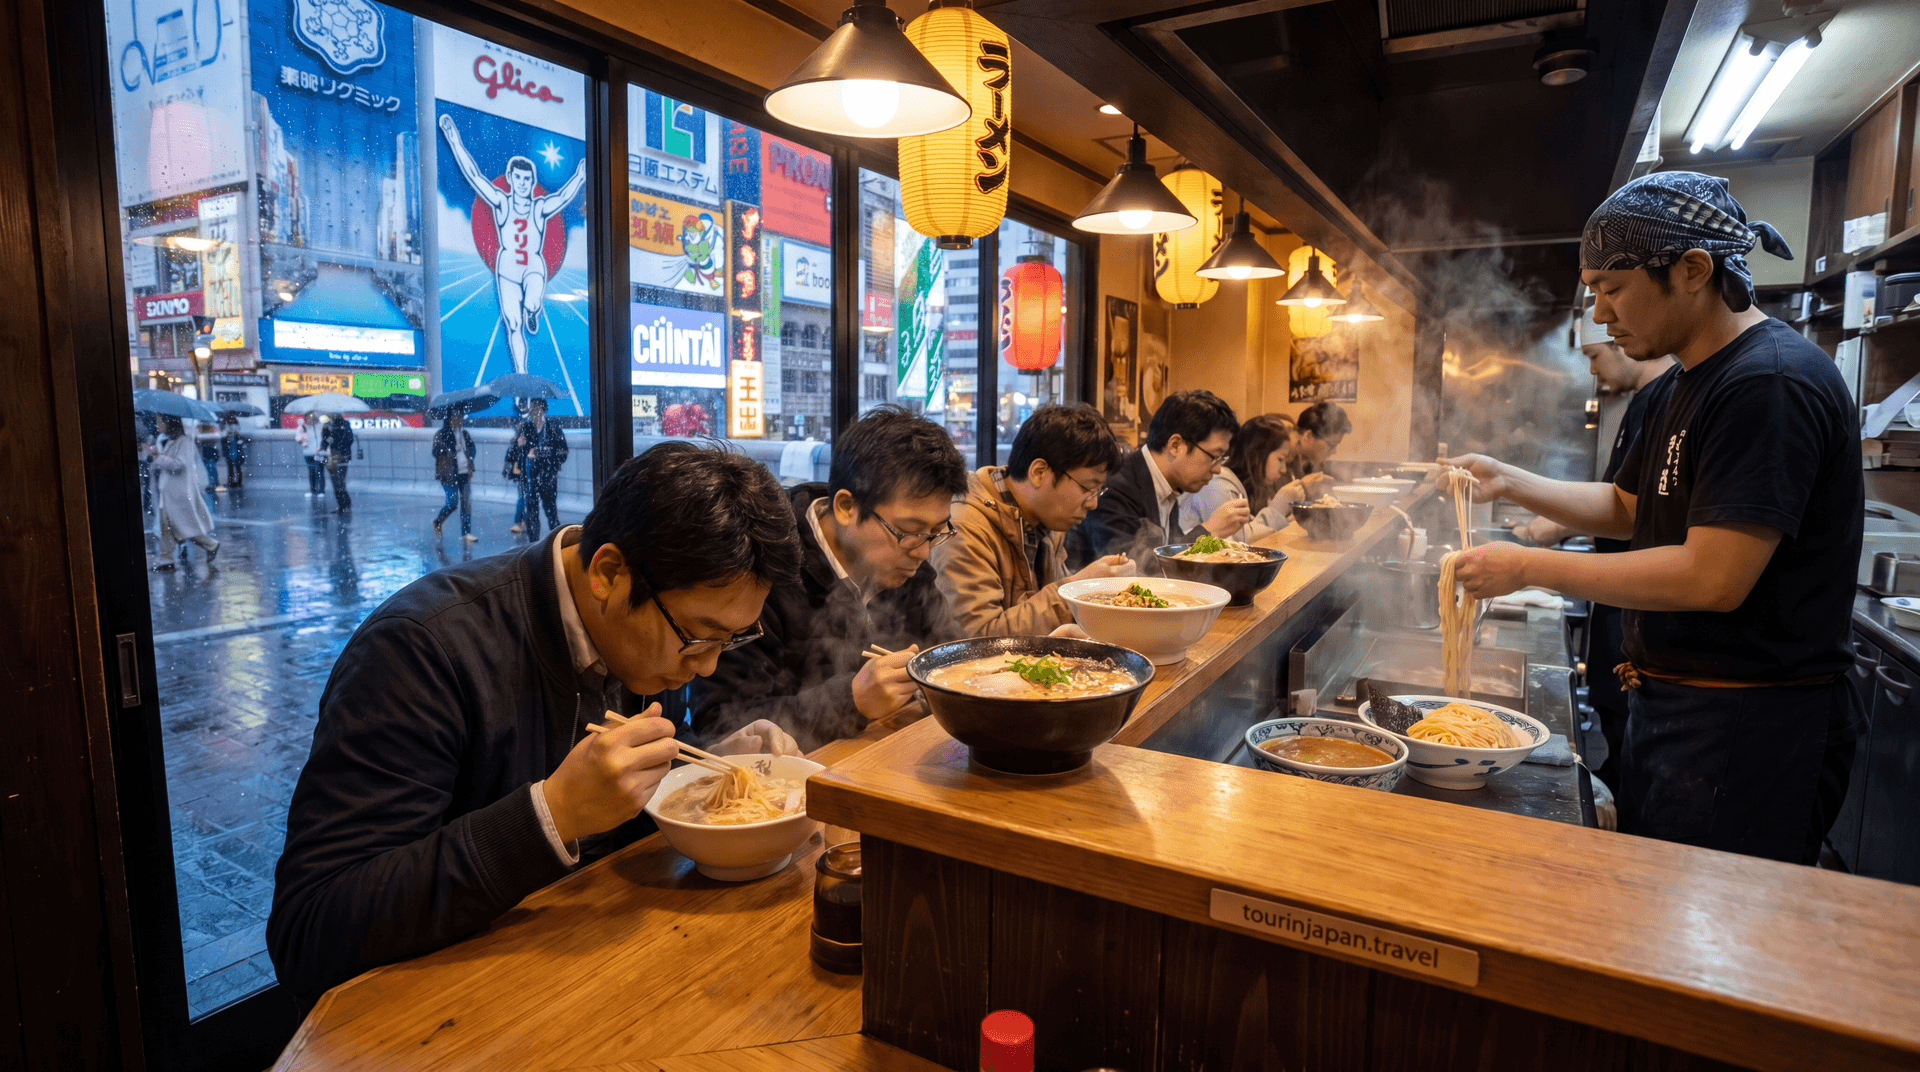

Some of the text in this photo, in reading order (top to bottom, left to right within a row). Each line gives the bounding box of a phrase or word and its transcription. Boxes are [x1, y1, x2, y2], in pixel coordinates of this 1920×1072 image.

[473, 55, 564, 103] Glico
[974, 39, 1010, 194] ラーメン
[1242, 904, 1440, 969] tourinjapan.travel
